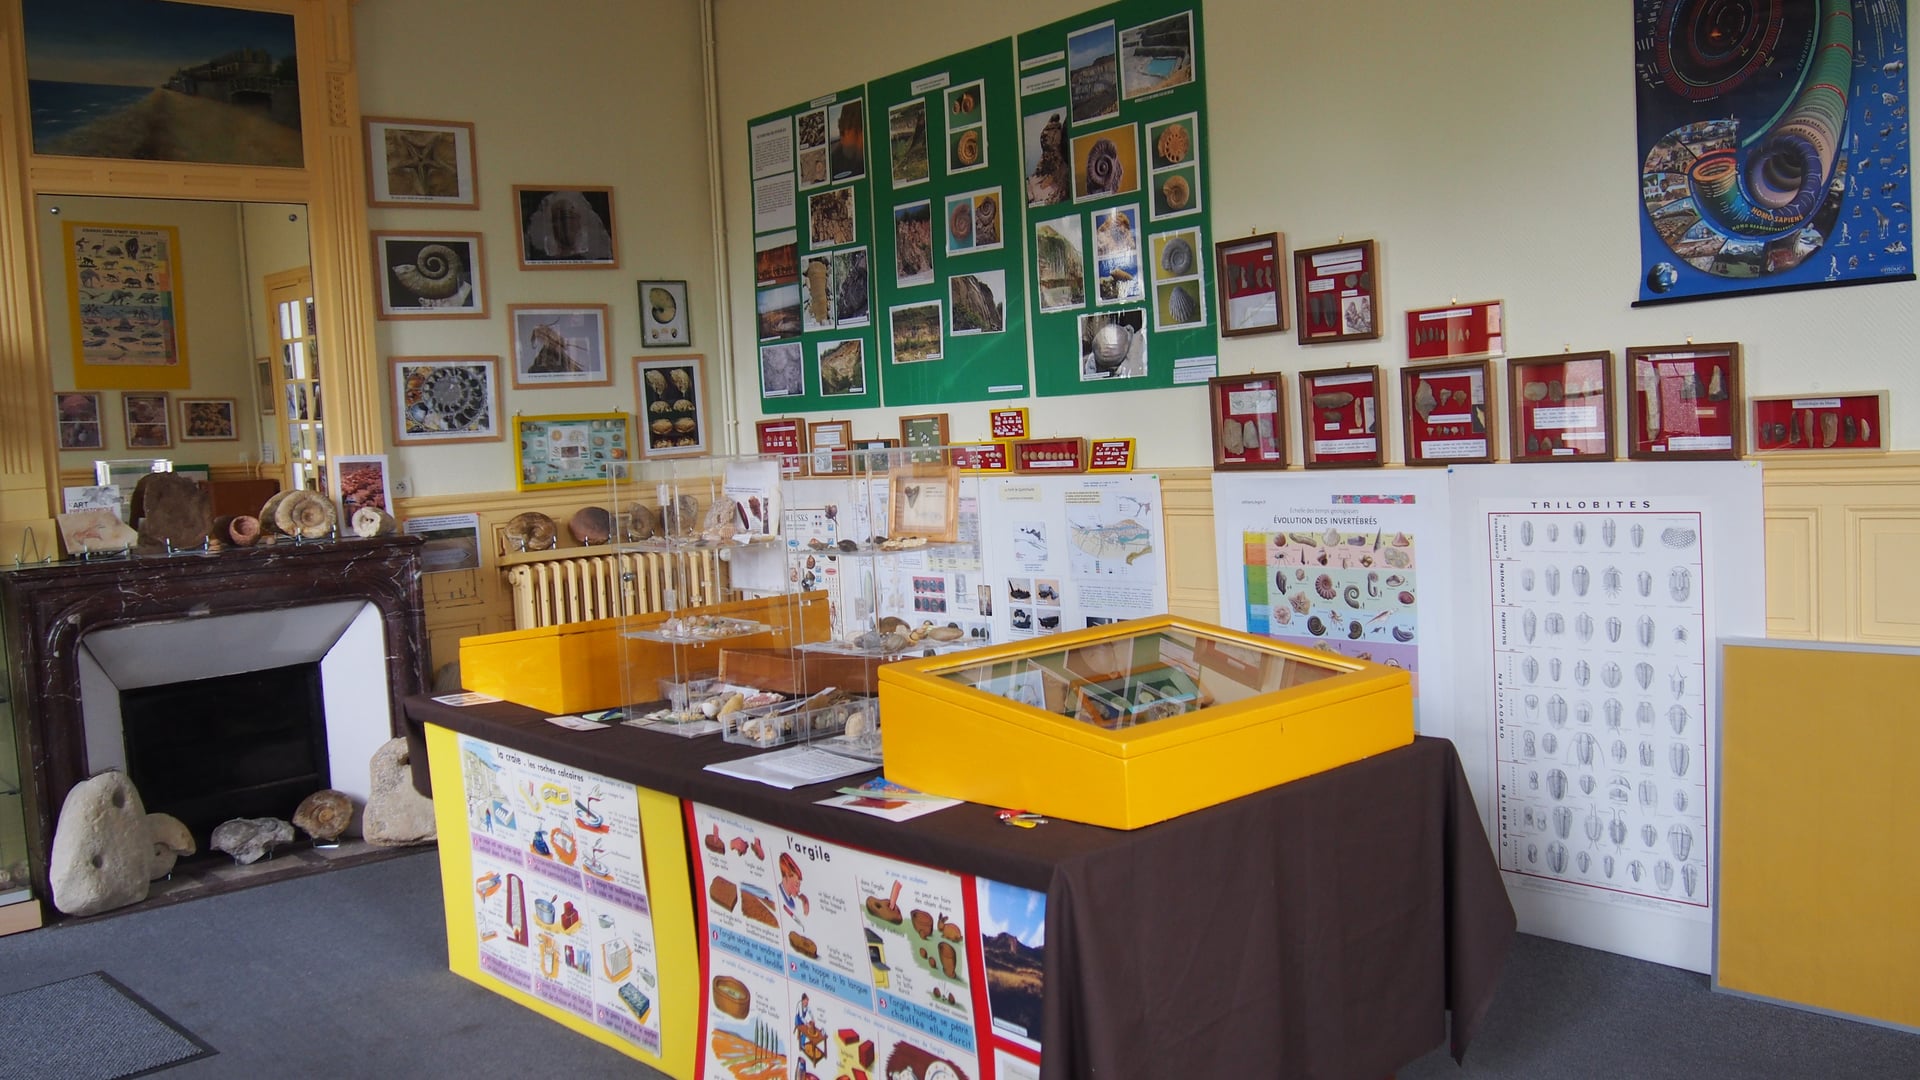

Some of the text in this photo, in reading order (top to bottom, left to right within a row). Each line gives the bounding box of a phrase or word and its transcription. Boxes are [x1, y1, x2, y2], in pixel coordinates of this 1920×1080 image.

[1751, 206, 1804, 224] HOMO SAPIENS
[1531, 500, 1650, 509] TRILOBITES
[1273, 514, 1378, 526] ÉVOLUTION DES INVERTÉBRÉS
[496, 747, 504, 758] la
[506, 753, 522, 766] craie
[528, 760, 536, 770] les
[538, 764, 556, 776] roches
[558, 769, 584, 782] calcaires
[786, 836, 830, 862] l'argile
